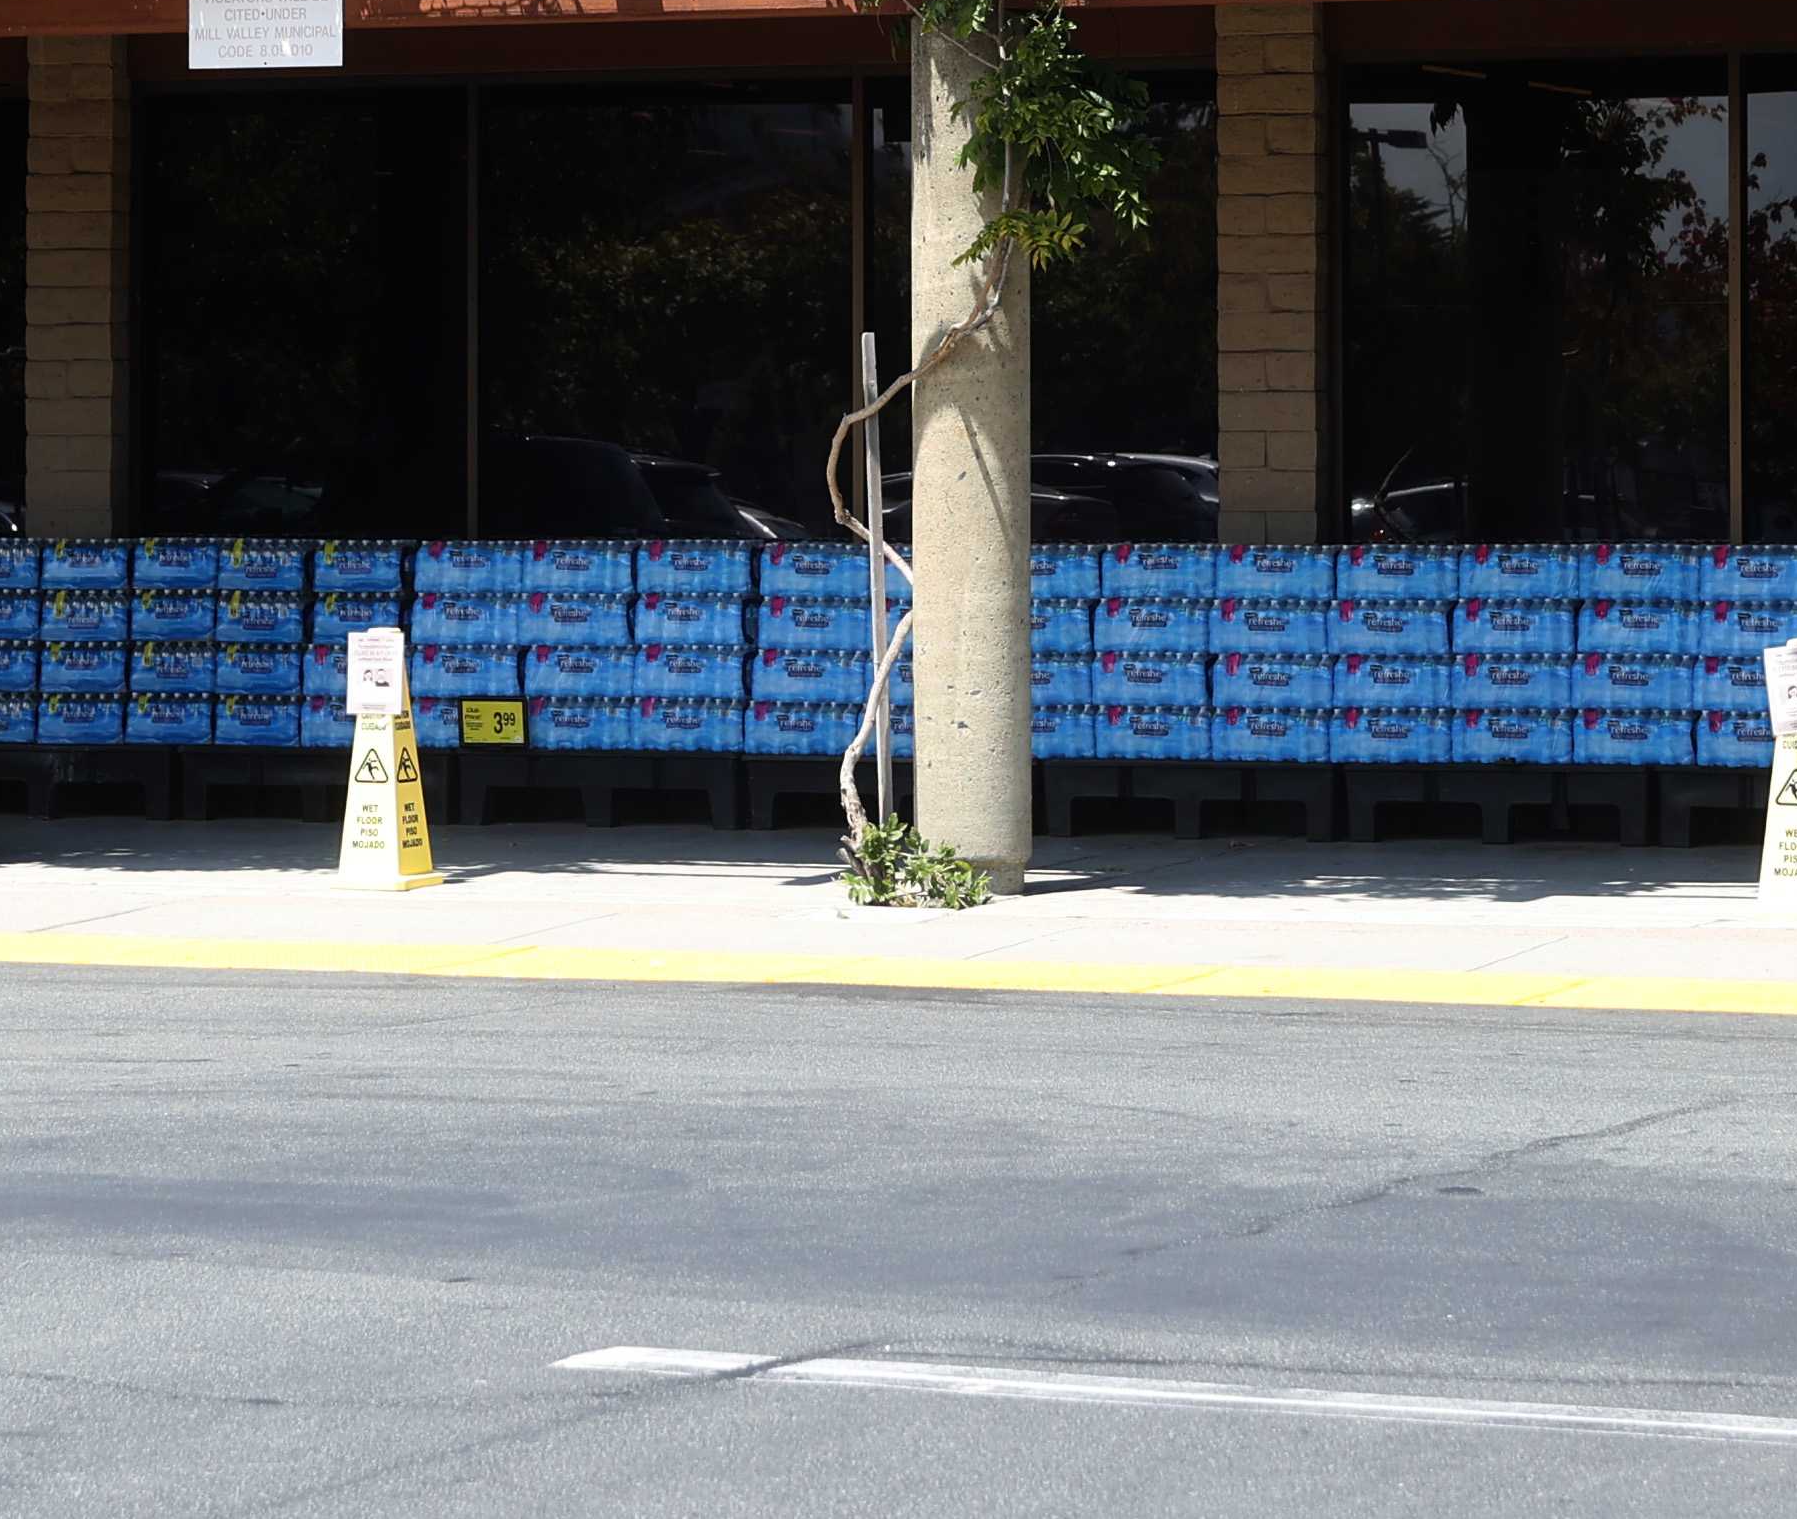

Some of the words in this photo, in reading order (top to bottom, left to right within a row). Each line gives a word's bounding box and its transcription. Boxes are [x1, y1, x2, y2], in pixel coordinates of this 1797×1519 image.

[224, 8, 260, 22] CITED
[265, 7, 307, 21] UNDER
[194, 29, 221, 42] MILL
[226, 27, 271, 40] VALLEY
[274, 25, 337, 40] MUNICIPAL
[218, 44, 253, 59] CODE
[362, 804, 379, 813] WET
[356, 816, 383, 825] FLOOR
[360, 828, 379, 837] PISO
[352, 840, 385, 850] MOJADO
